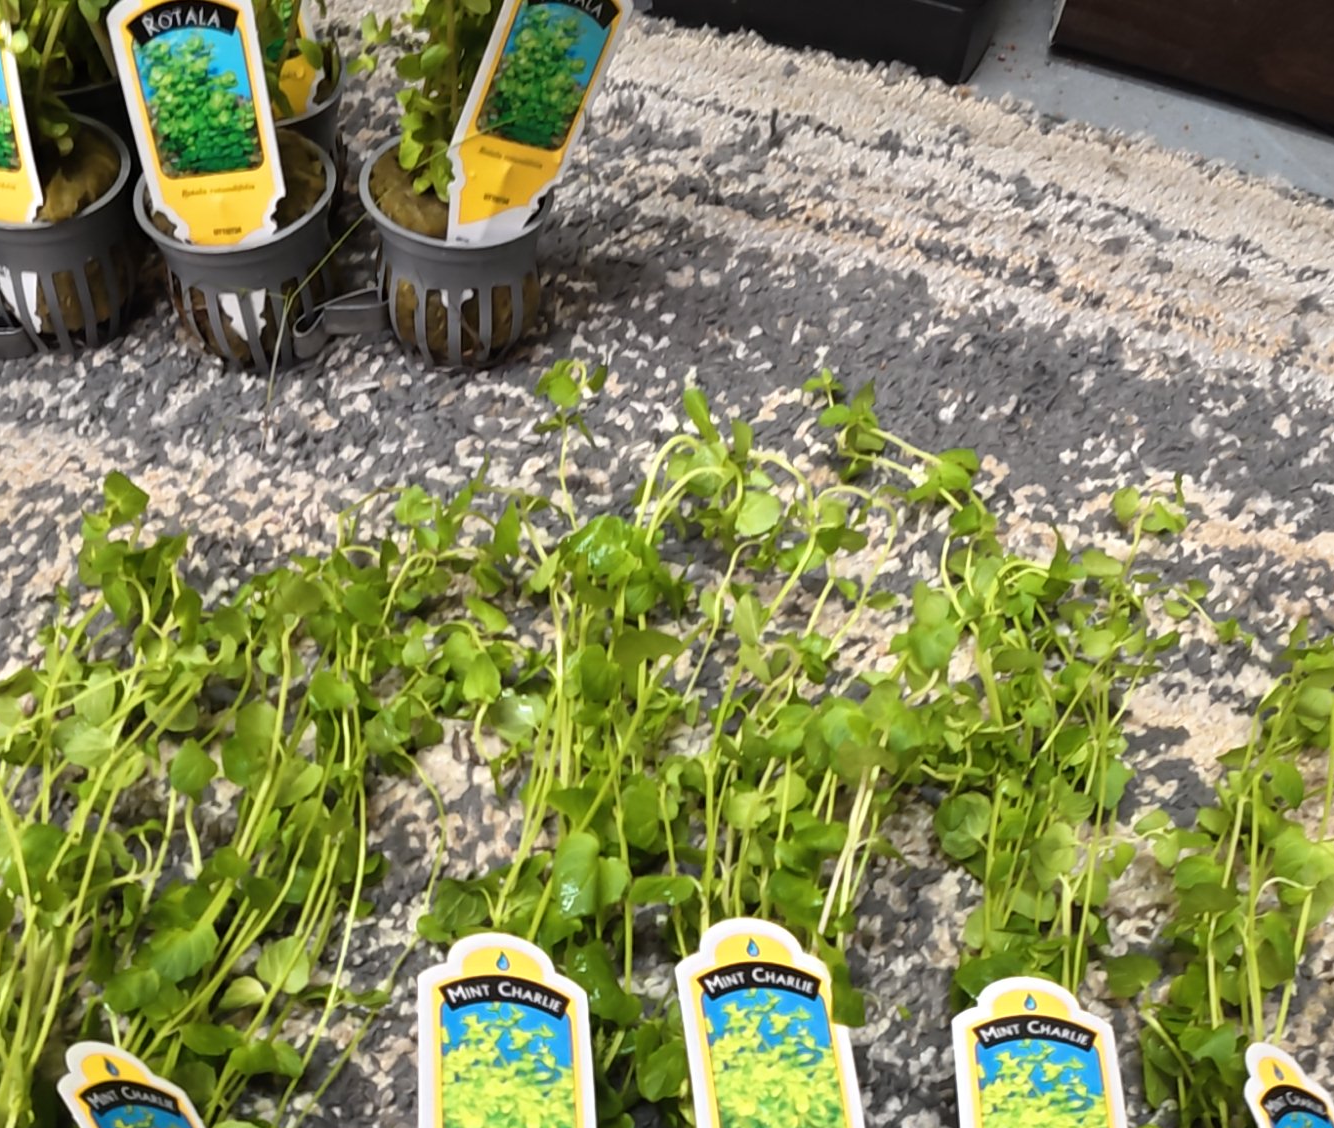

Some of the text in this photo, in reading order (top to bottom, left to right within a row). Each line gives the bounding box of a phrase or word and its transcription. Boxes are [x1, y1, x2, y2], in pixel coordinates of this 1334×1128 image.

[141, 6, 222, 37] ROTALA
[703, 967, 815, 995] MINT CHARLIE
[446, 981, 563, 1013] MINT CHARLIE
[979, 1020, 1091, 1046] MINT CHARLIE
